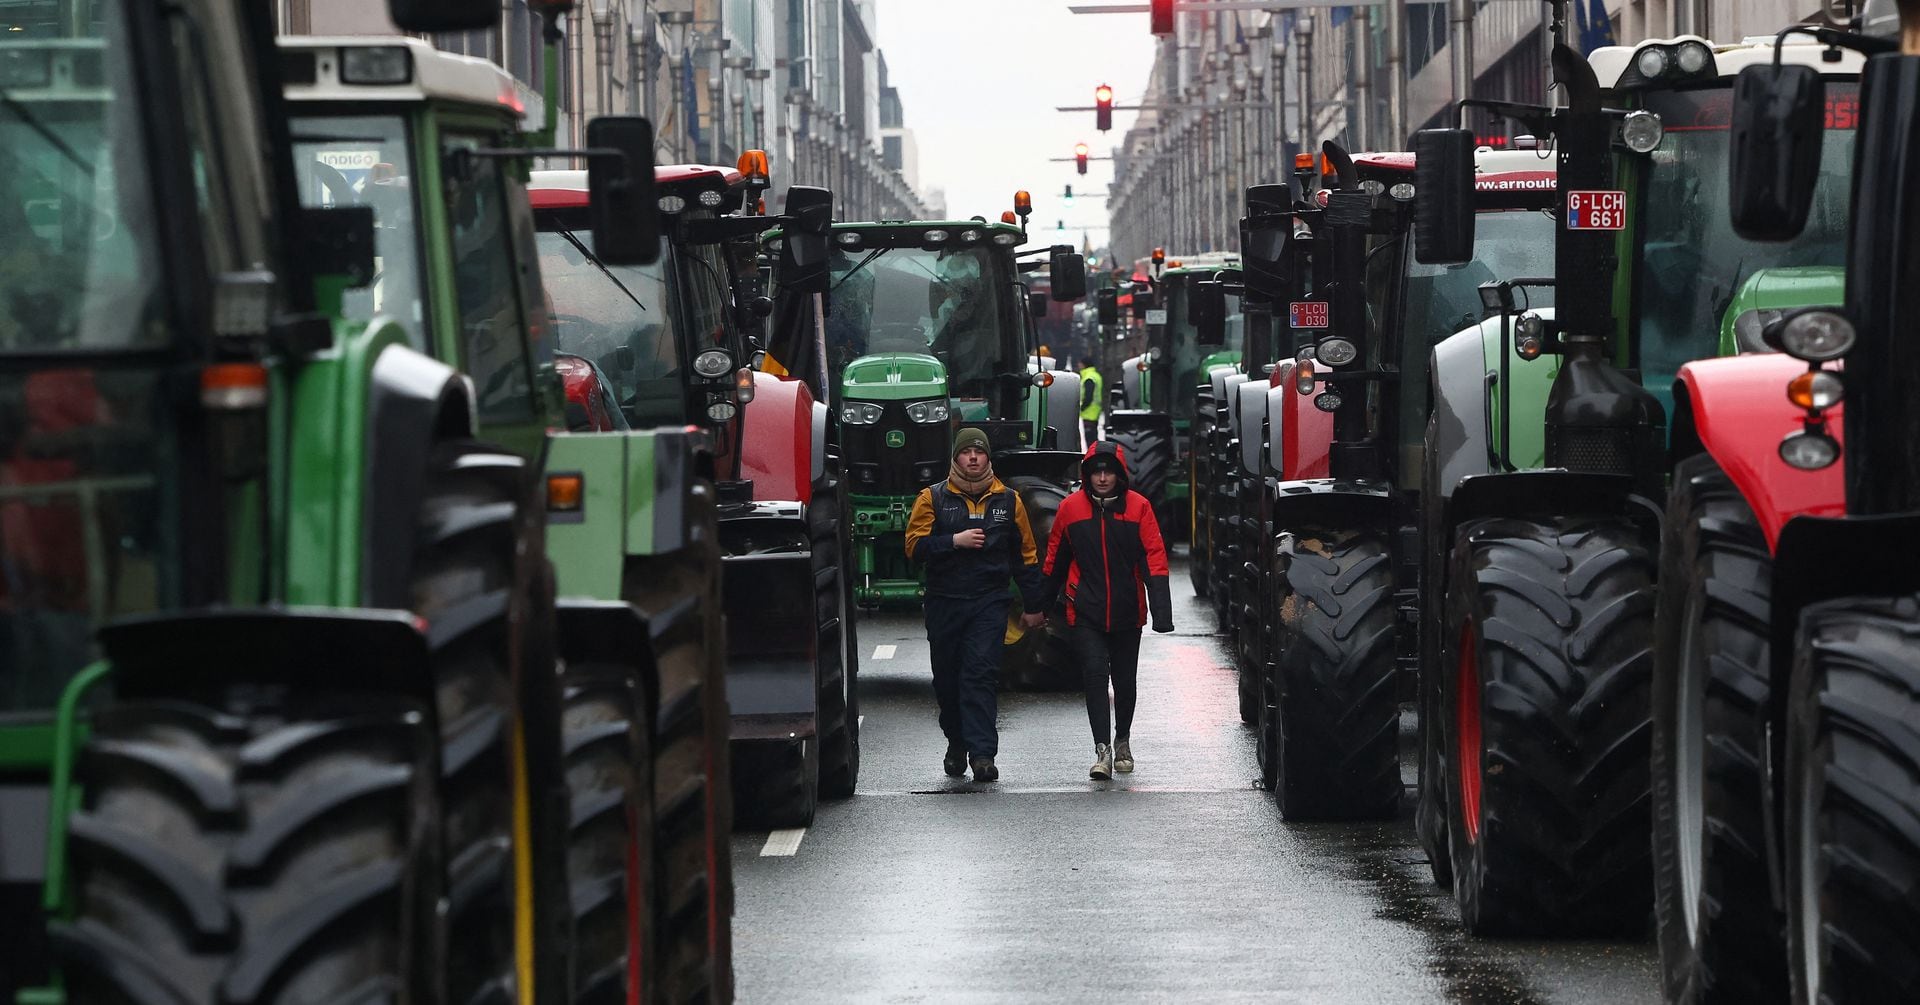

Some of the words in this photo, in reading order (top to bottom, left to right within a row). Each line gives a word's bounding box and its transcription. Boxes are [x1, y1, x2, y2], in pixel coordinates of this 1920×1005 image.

[323, 154, 373, 165] INDIGO
[1570, 193, 1623, 210] G-LCH
[1590, 210, 1621, 227] 661
[1292, 303, 1326, 315] G-LCU
[1305, 315, 1326, 326] 030
